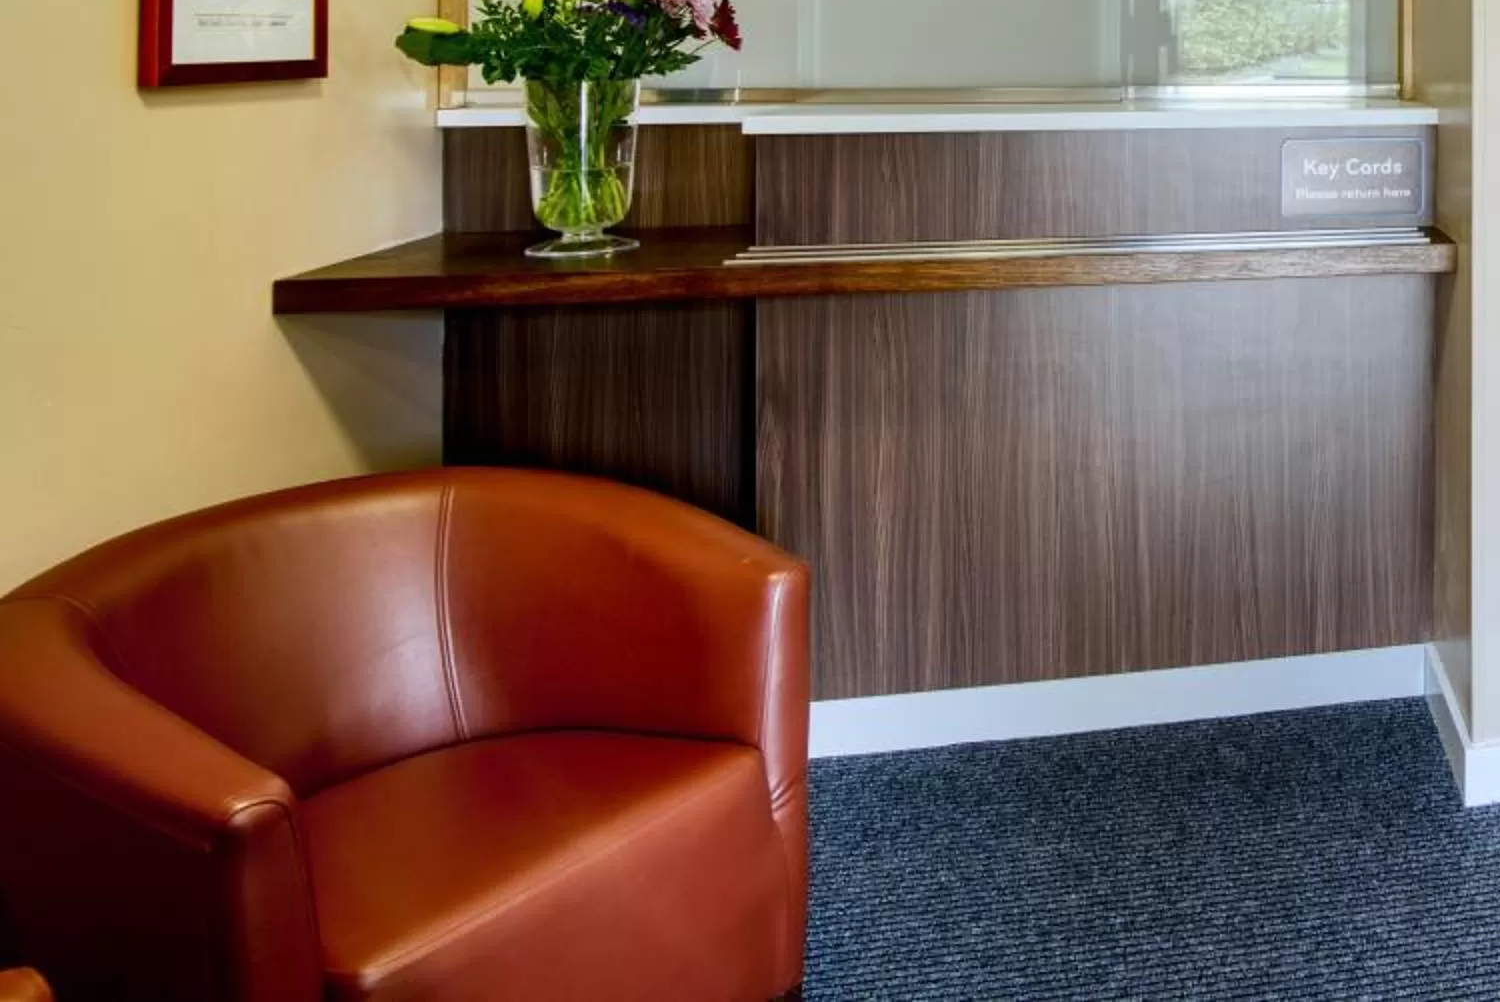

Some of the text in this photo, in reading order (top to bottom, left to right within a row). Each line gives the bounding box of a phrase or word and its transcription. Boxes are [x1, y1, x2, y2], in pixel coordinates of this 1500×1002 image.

[1303, 157, 1403, 181] Key Cards
[1295, 185, 1412, 199] Please return here
